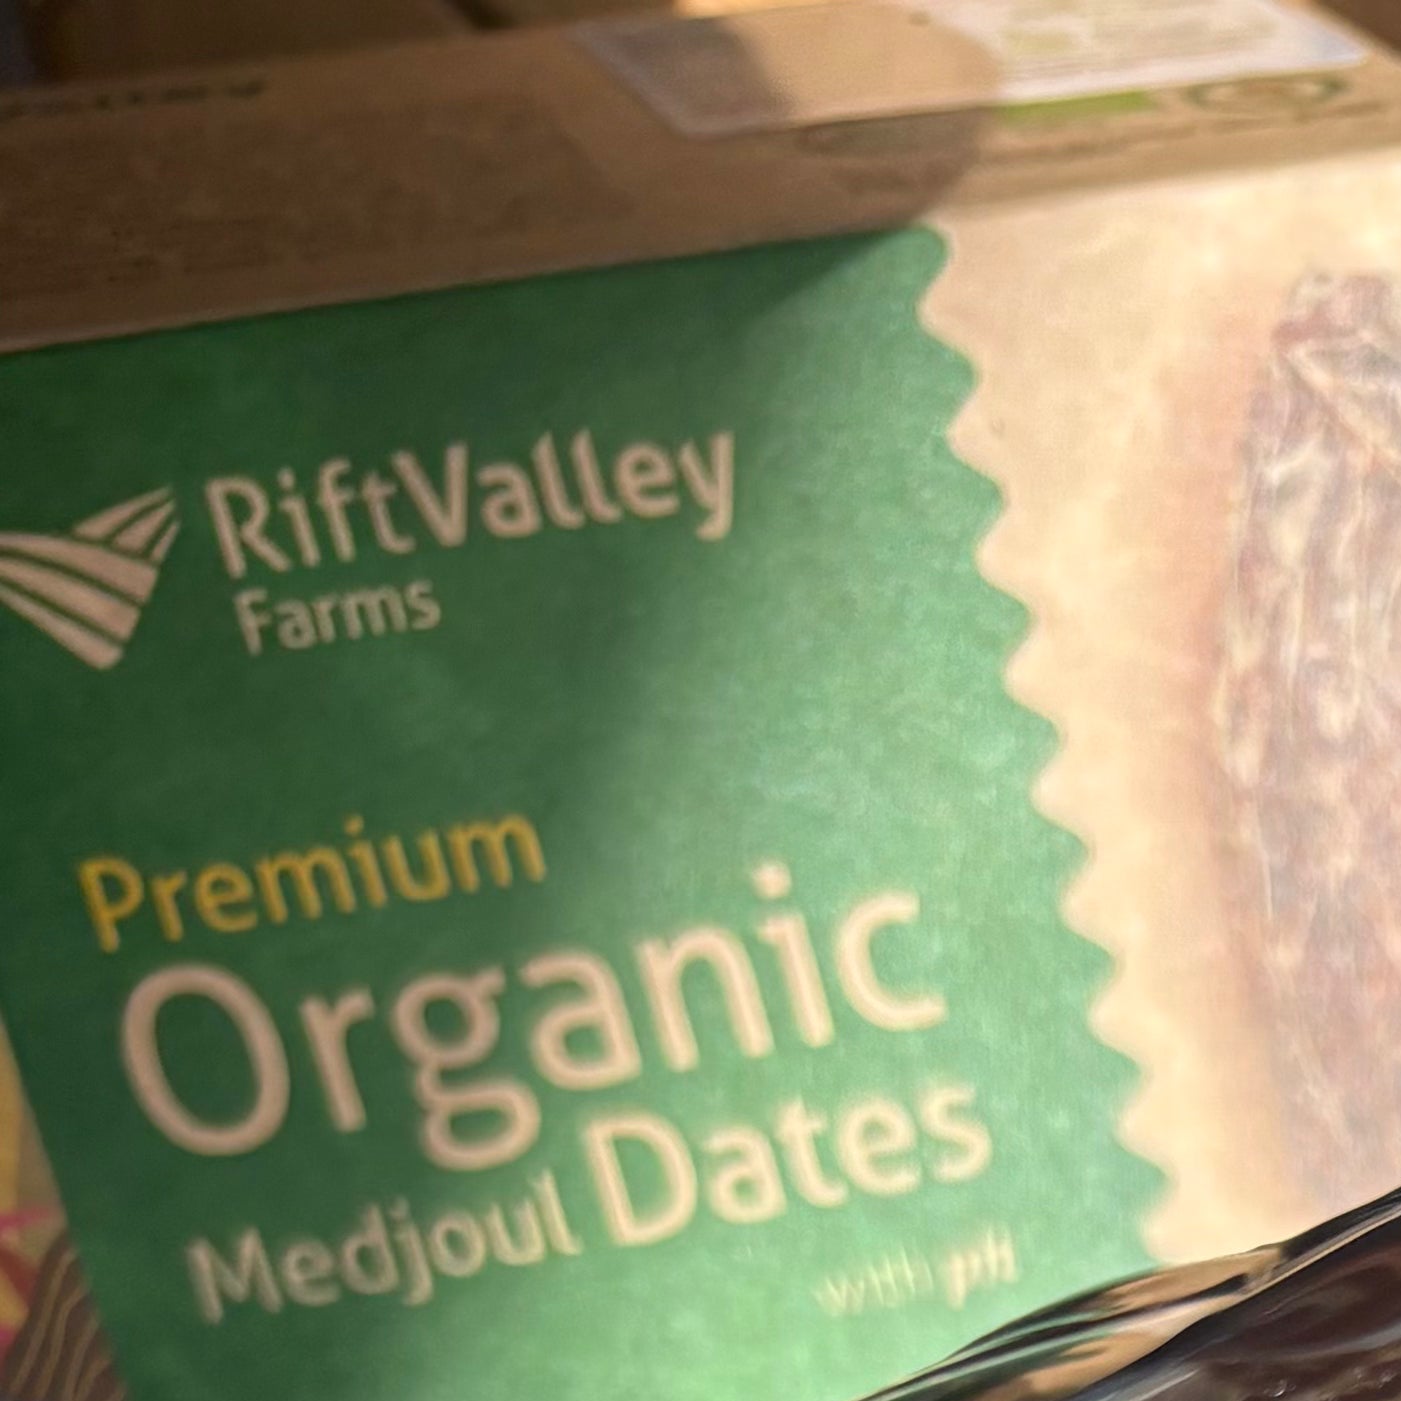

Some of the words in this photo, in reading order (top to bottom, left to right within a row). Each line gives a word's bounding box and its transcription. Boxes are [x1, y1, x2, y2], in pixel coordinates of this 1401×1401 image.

[204, 428, 736, 580] RiftValley
[232, 579, 442, 656] Farms
[78, 812, 547, 954] Premium
[119, 860, 948, 1173] Organic
[184, 1170, 582, 1324] Medjoul
[577, 1080, 993, 1247] Dates
